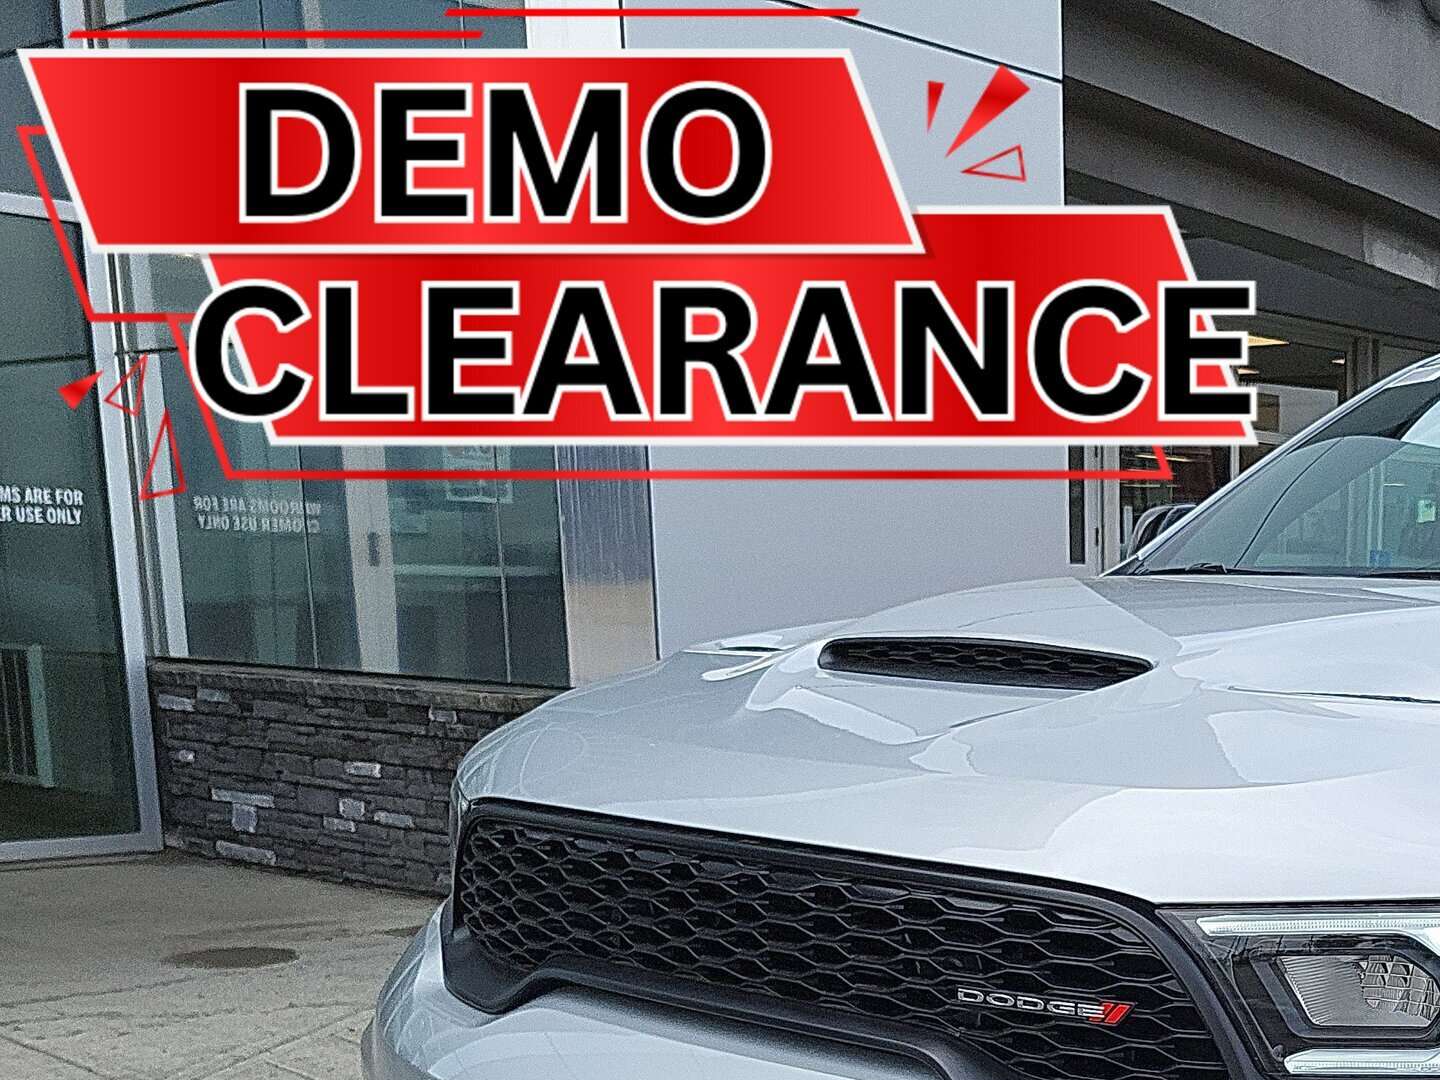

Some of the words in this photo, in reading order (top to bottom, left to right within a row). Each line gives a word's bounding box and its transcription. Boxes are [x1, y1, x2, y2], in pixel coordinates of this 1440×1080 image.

[25, 486, 53, 504] ARE
[55, 487, 83, 506] FOR
[15, 505, 45, 523] USE
[46, 506, 81, 525] ONLY
[957, 987, 1105, 1019] DODGE
